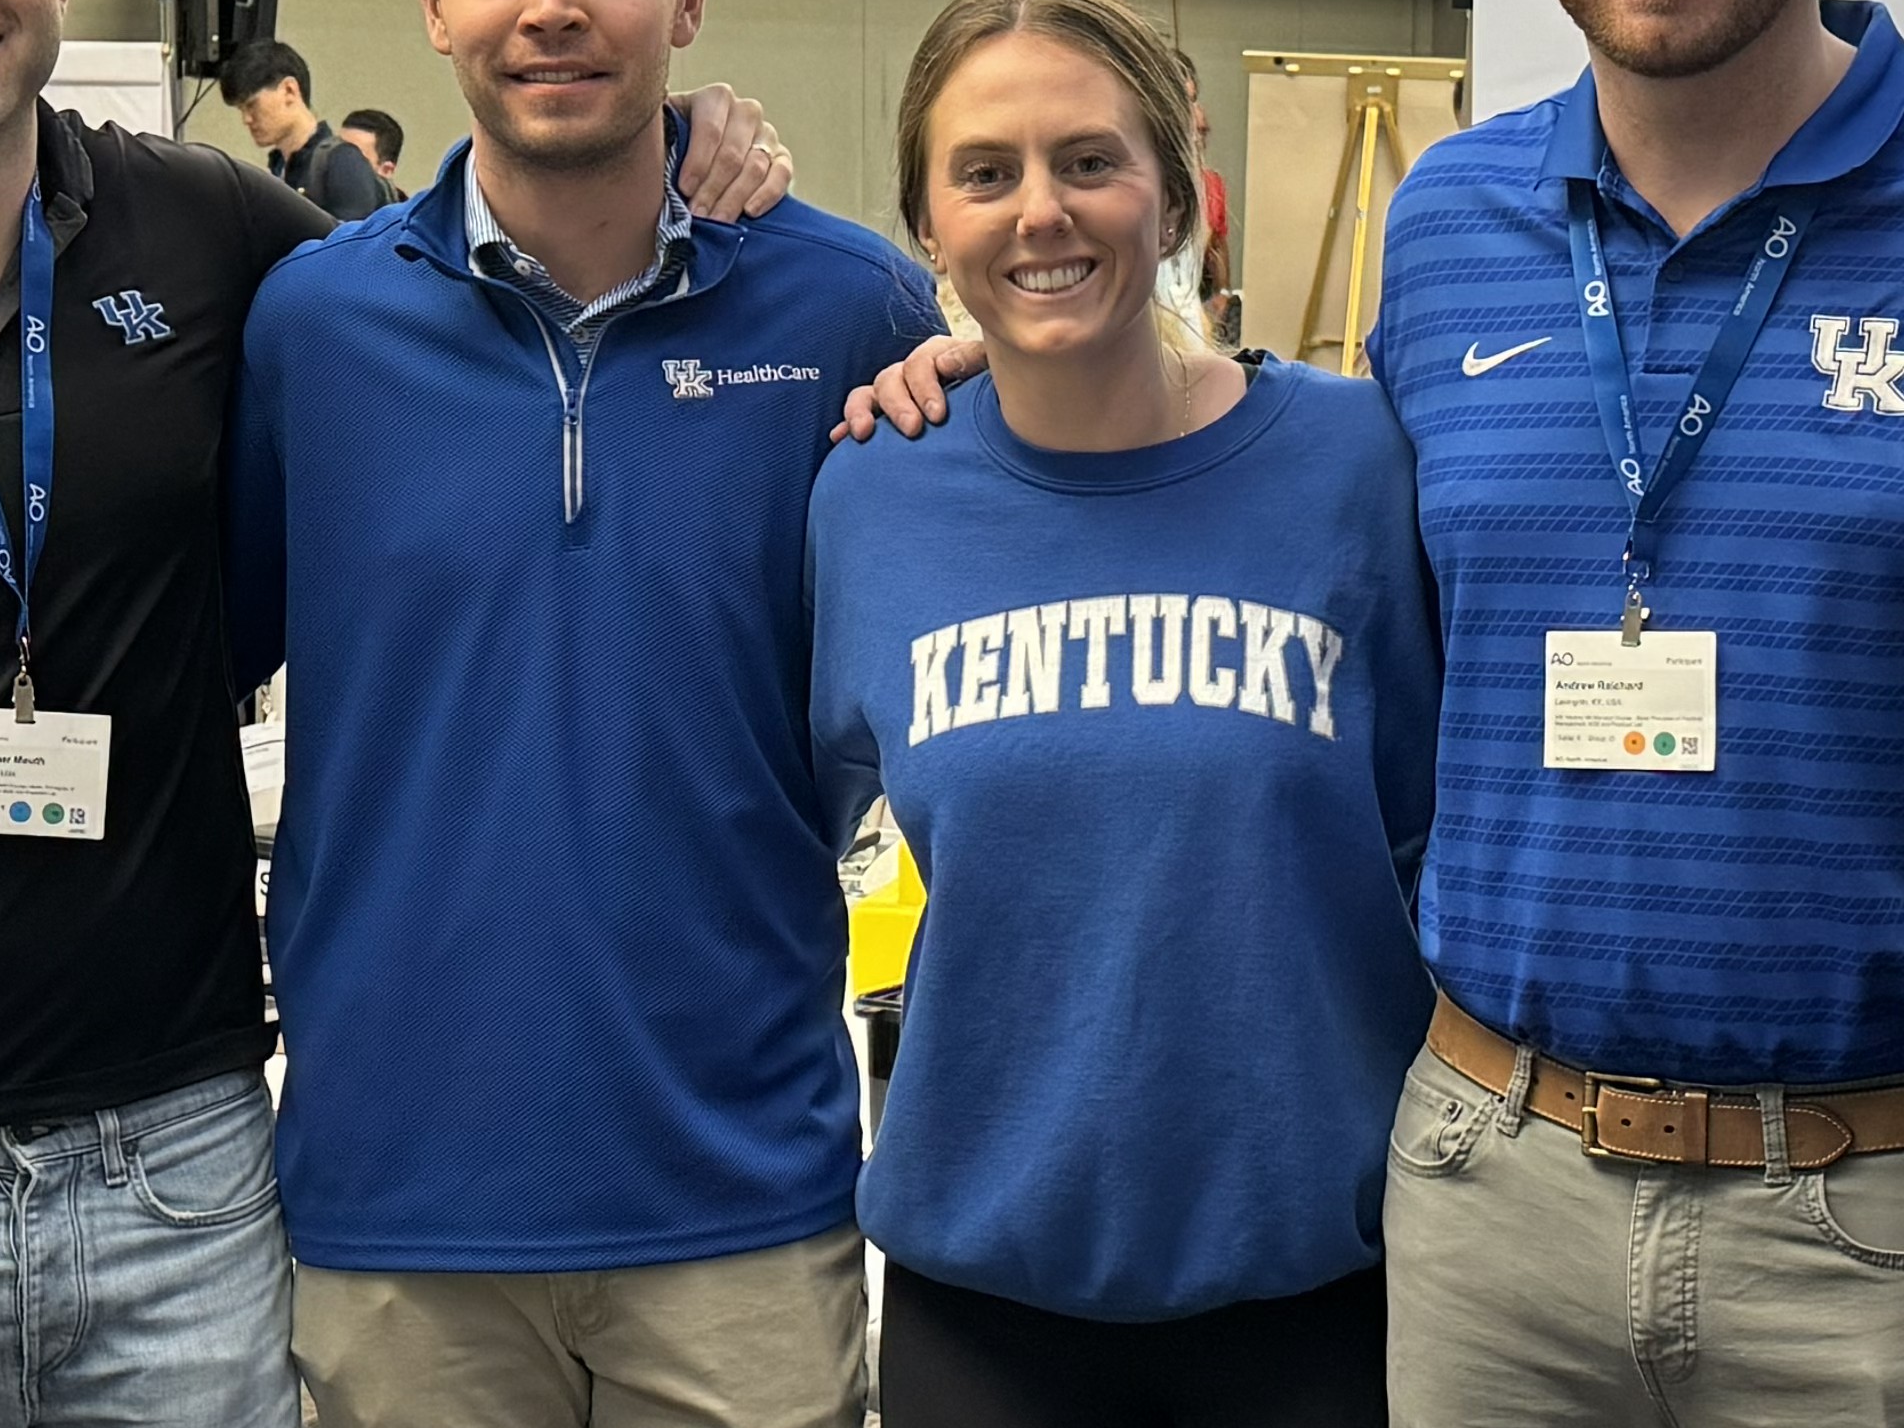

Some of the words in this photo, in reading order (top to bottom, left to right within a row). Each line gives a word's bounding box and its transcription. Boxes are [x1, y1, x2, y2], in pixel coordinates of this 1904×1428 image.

[1763, 215, 1797, 259] AO
[92, 290, 172, 345] UK
[1583, 280, 1610, 317] AO
[25, 314, 46, 353] AO
[662, 359, 714, 399] UK
[717, 363, 821, 386] HealthCare
[1679, 392, 1713, 437] AO
[28, 483, 47, 522] AO
[908, 593, 1344, 748] KENTUCKY
